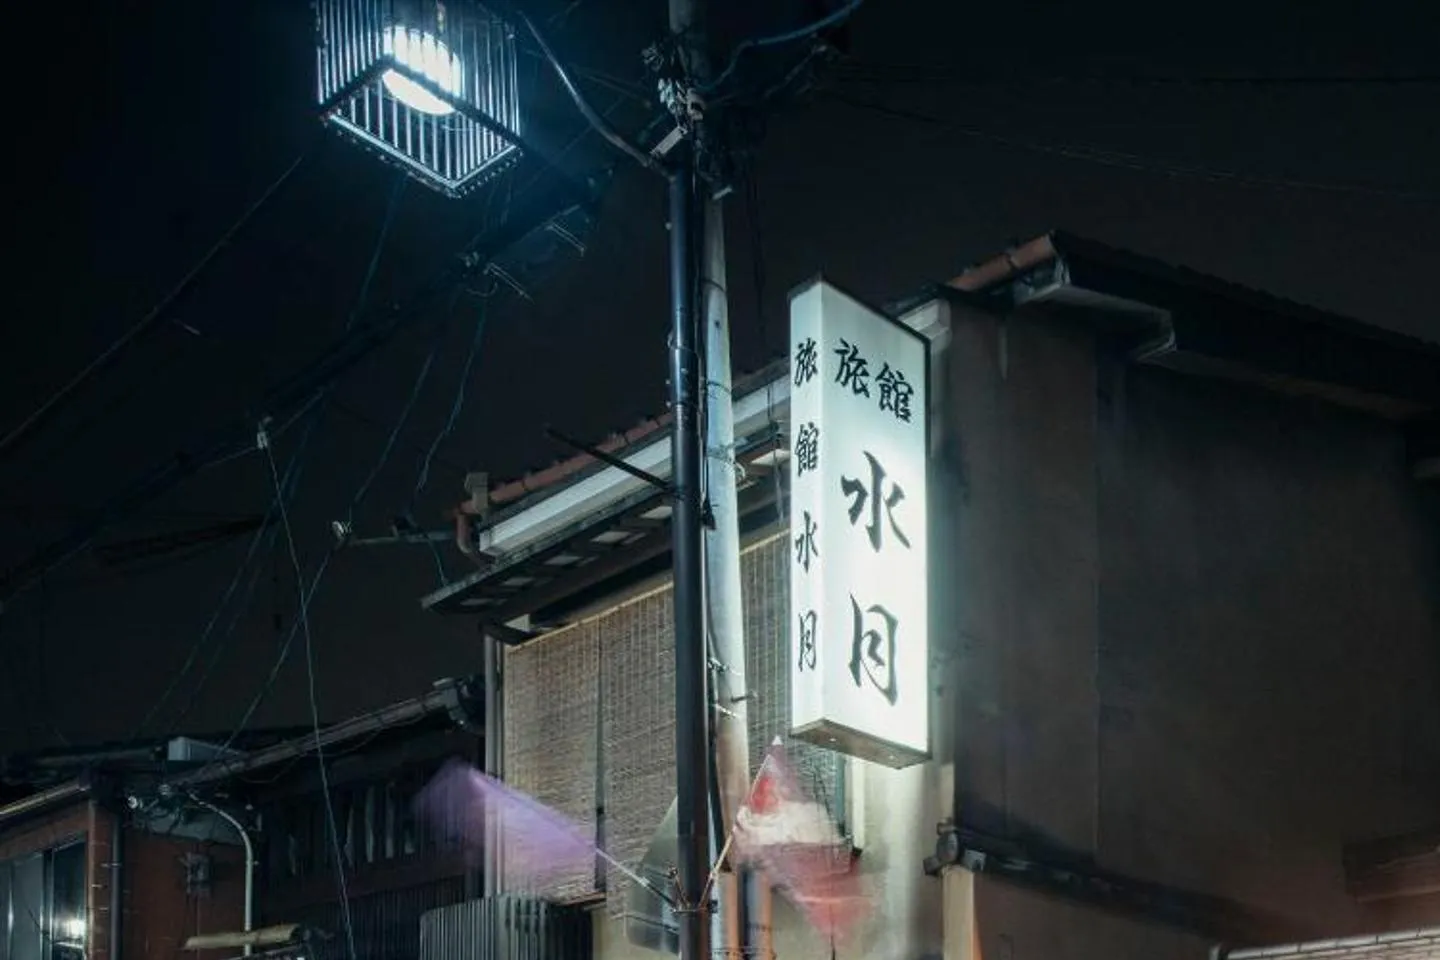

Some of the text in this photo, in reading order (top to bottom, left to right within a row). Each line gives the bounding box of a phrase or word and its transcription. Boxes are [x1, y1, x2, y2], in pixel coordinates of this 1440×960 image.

[794, 336, 820, 673] 旅館水月
[833, 337, 915, 424] 旅館
[841, 450, 911, 707] 水月
